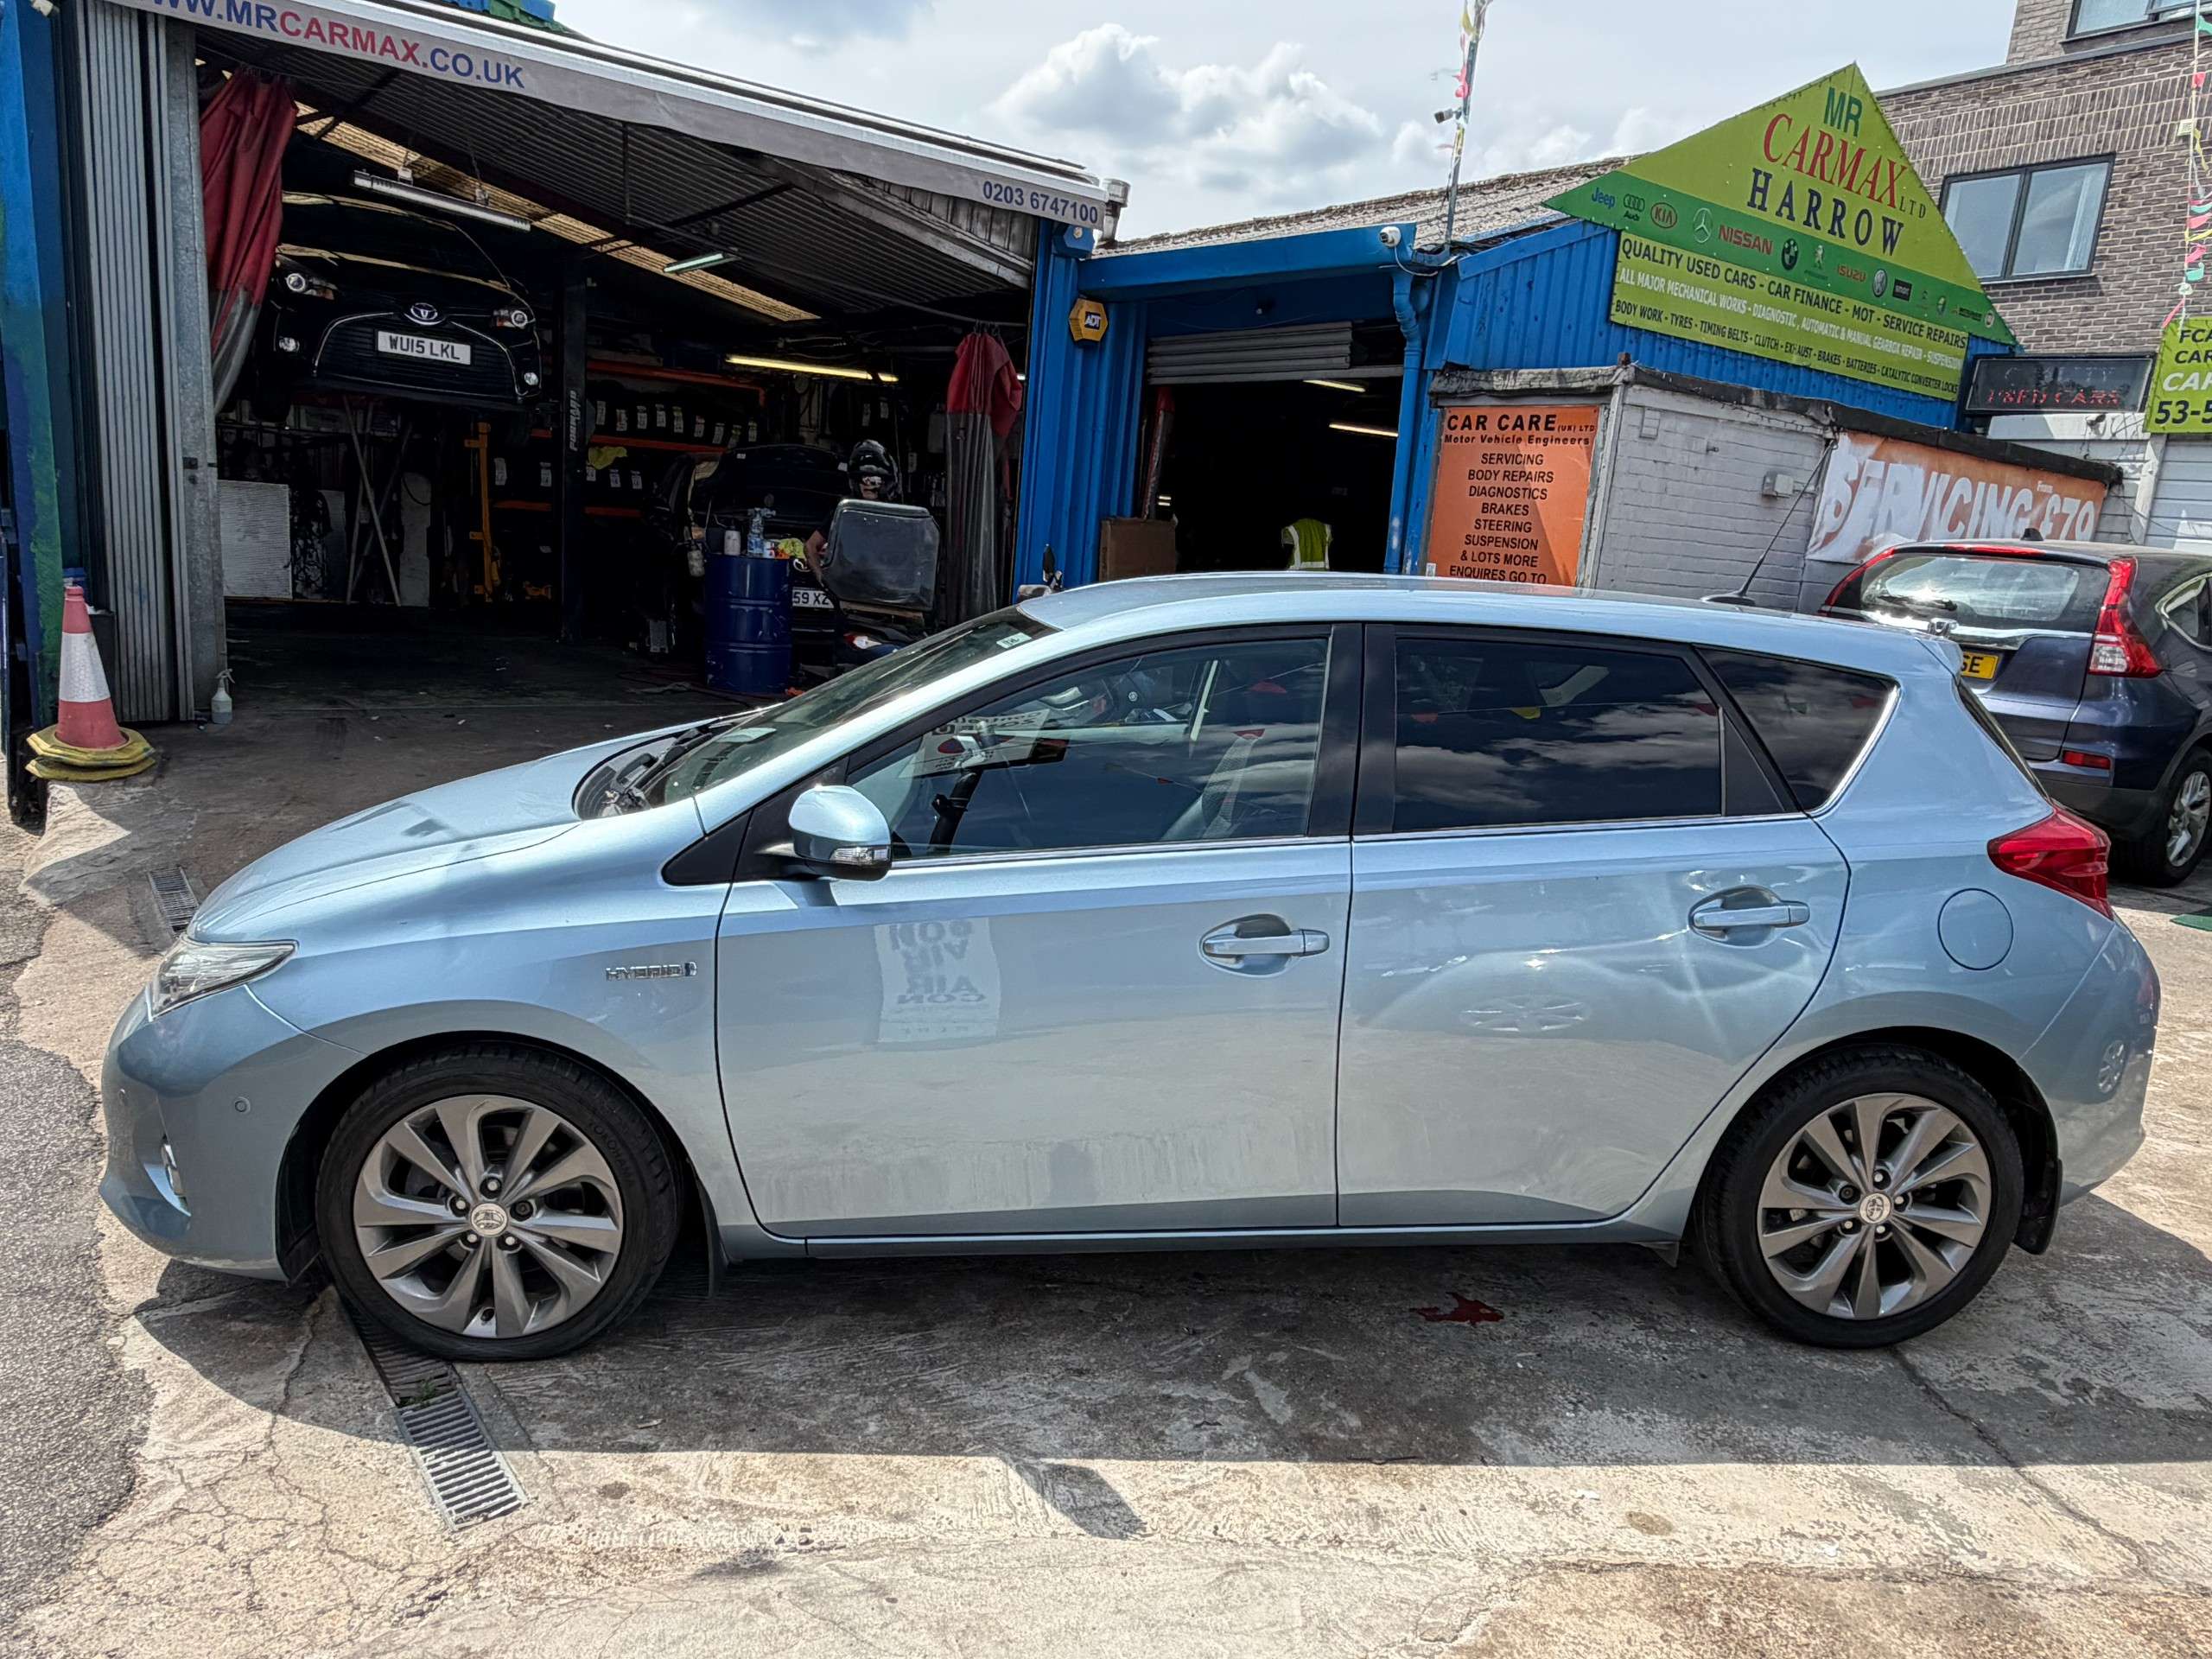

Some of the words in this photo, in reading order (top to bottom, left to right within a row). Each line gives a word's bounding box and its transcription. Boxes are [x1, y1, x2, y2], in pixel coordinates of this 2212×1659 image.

[153, 0, 524, 88] W.MRCARMAX.CO.UK
[1824, 86, 1862, 137] MR
[1764, 113, 1907, 208] CARMAX
[1900, 196, 1926, 219] LTD
[983, 181, 1024, 206] 0203
[1030, 192, 1097, 224] 6747100
[1592, 188, 1615, 209] Jeep
[1654, 207, 1673, 223] KIA
[1746, 168, 1904, 256] HARROW
[1719, 225, 1772, 255] NISSAN
[1837, 264, 1866, 283] ISUZU
[1619, 268, 1635, 284] ALL
[1637, 273, 1665, 291] MAJOR
[1667, 280, 1717, 307] MECHANICAL
[1719, 295, 1747, 315] WORKS
[1752, 303, 1797, 327] DIAGNOSTIC
[1622, 238, 1683, 269] QUALITY
[1687, 257, 1720, 279] USED
[1725, 268, 1757, 289] CARS
[1768, 281, 1790, 300] CAR
[1794, 289, 1841, 314] FINANCE
[1853, 305, 1875, 323] MOT
[1883, 315, 1923, 337] SERVICE
[1926, 328, 1966, 348] REPAIRS
[1084, 314, 1102, 328] ADT
[1615, 300, 1637, 316] BODY
[1640, 306, 1664, 323] WORK
[1670, 313, 1693, 329] TYRES
[1700, 321, 1727, 338] TIMING
[1727, 327, 1749, 343] BELTS
[1754, 334, 1779, 350] CLUTCH
[1817, 350, 1840, 365] BRAKES
[1846, 357, 1878, 374] BATTERIES
[390, 335, 425, 354] WU15
[429, 342, 461, 359] LKL
[1446, 415, 1488, 430] CAR
[1497, 414, 1557, 431] CARE
[1444, 435, 1475, 444] Motor
[1480, 435, 1522, 444] Vehicle
[1528, 435, 1590, 446] Engineers
[1481, 453, 1543, 465] SERVICING
[1468, 469, 1500, 481] BODY
[1503, 470, 1554, 483] REPAIRS
[1468, 486, 1548, 500] DIAGNOSTICS
[1821, 439, 2033, 543] SERVICING
[1481, 502, 1529, 516] BRAKES
[1474, 518, 1532, 533] STEERING
[1465, 534, 1538, 550] SUSPENSION
[1460, 551, 1468, 562] &
[1471, 551, 1501, 563] LOTS
[1503, 554, 1539, 568] MORE
[1449, 565, 1506, 582] ENQUIRES
[1509, 570, 1528, 583] GO
[1530, 572, 1547, 584] TO
[792, 591, 809, 604] 59
[605, 964, 681, 982] HYBRID
